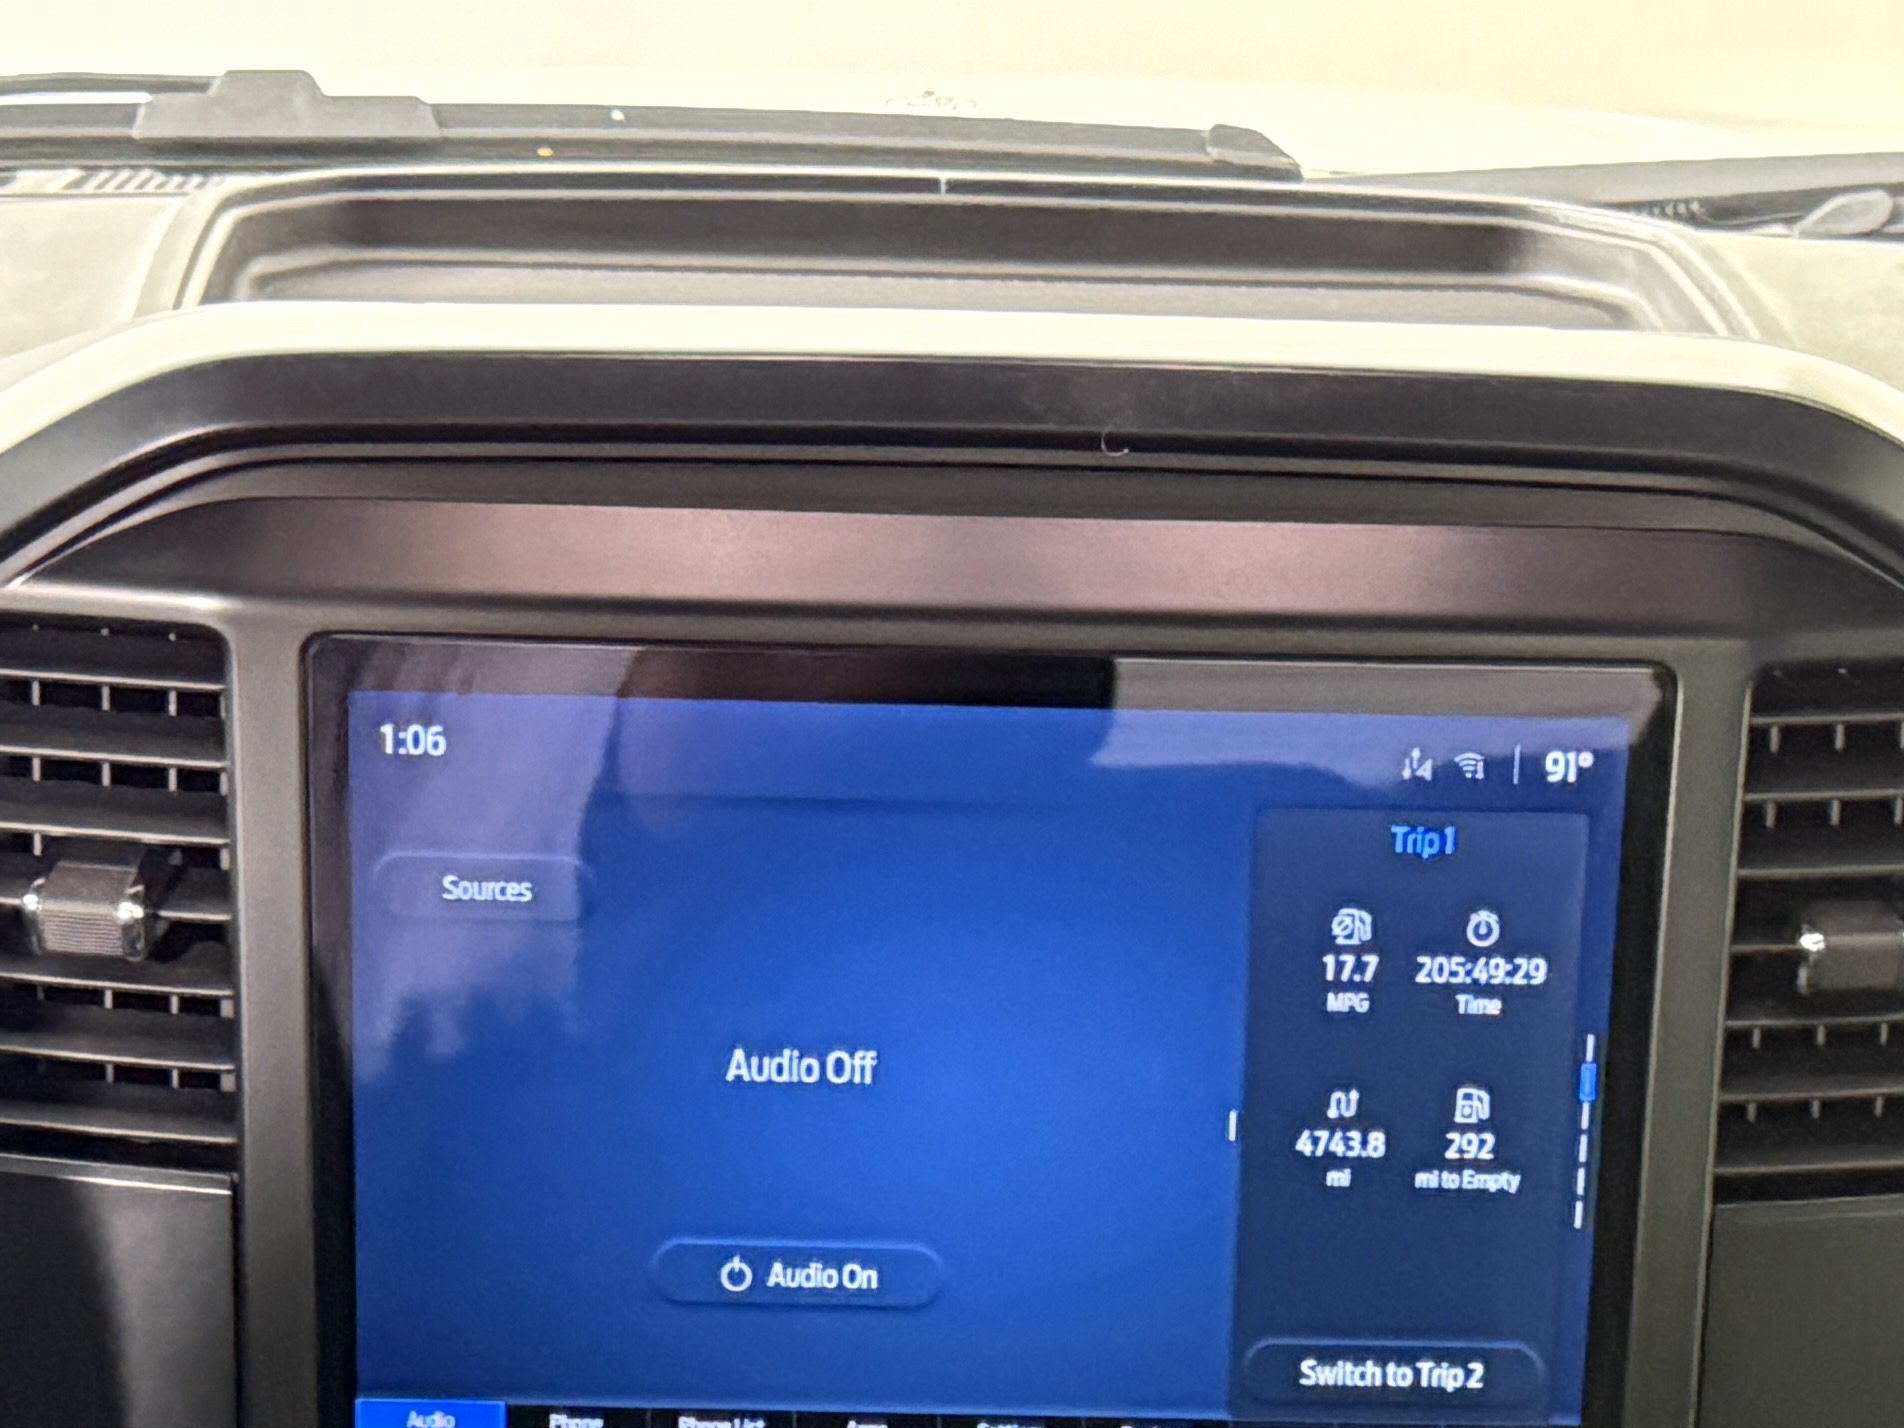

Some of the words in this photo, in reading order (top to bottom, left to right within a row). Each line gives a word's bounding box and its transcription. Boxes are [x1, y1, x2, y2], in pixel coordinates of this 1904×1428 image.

[380, 723, 446, 756] 1:06
[1391, 824, 1439, 859] Trip
[1445, 825, 1456, 855] 1
[442, 874, 533, 902] Sources
[1322, 954, 1379, 982] 17.7
[1415, 956, 1548, 985] 205:49:29
[1326, 992, 1370, 1013] MPG
[1455, 994, 1502, 1015] Time
[726, 1048, 820, 1083] Audio
[826, 1049, 878, 1085] Off
[1295, 1130, 1386, 1158] 4743.8
[1444, 1132, 1496, 1160] 292
[1325, 1168, 1352, 1187] mi
[1414, 1170, 1439, 1188] mi
[1440, 1171, 1460, 1189] to
[1461, 1169, 1522, 1194] Empty
[766, 1262, 838, 1289] Audio
[842, 1263, 879, 1290] On
[1299, 1359, 1382, 1387] Switch
[1386, 1362, 1413, 1388] to
[1415, 1361, 1464, 1392] Trip
[1466, 1362, 1485, 1389] 2
